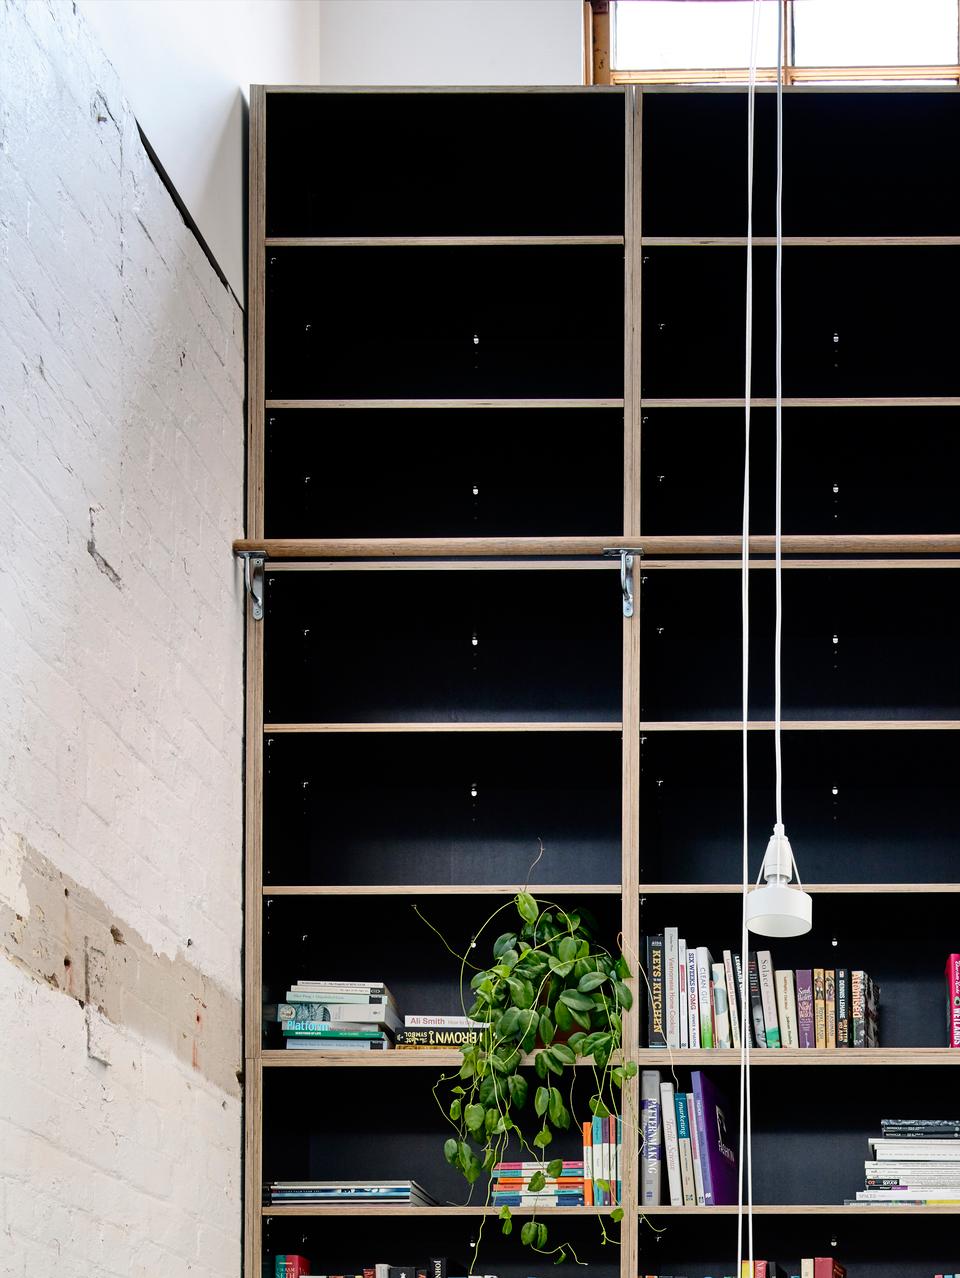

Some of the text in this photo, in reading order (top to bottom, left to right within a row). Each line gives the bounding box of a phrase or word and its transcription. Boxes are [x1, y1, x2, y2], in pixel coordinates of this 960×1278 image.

[761, 959, 769, 987] Solace
[652, 950, 662, 1033] KEYS KITCHEN
[852, 973, 863, 1018] Atomised
[287, 1020, 330, 1031] Platform
[647, 1098, 657, 1174] PATTERNMAKING
[666, 1119, 675, 1142] Textile
